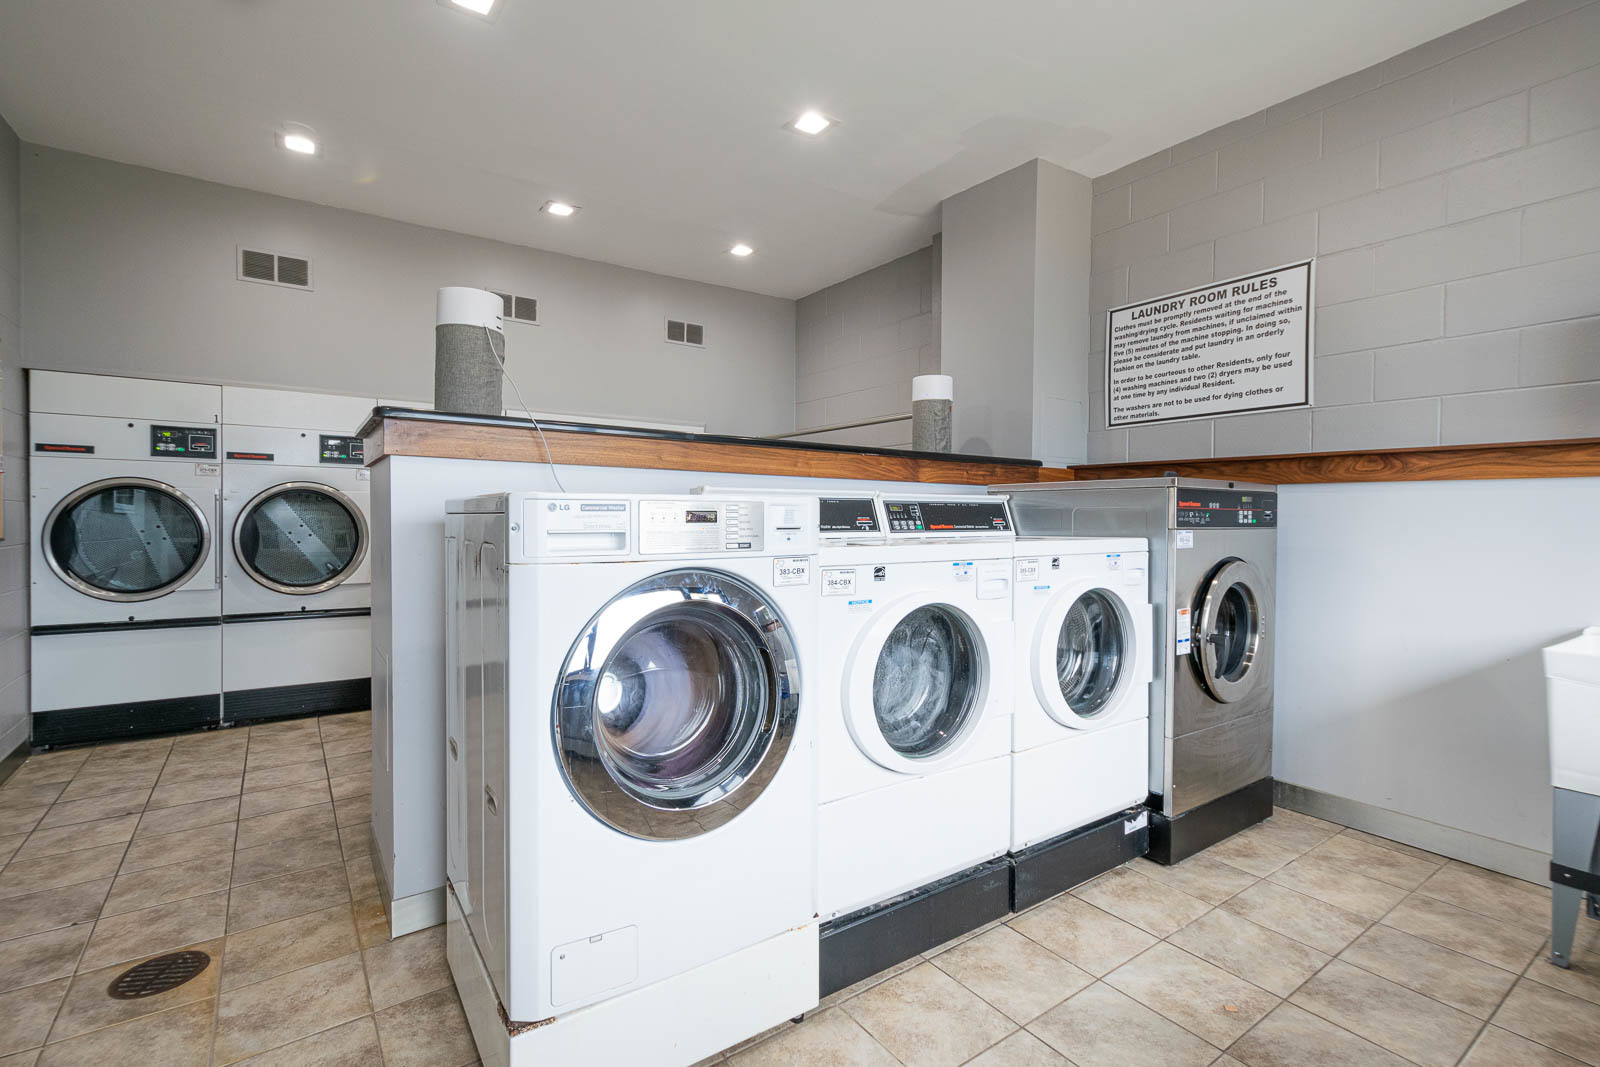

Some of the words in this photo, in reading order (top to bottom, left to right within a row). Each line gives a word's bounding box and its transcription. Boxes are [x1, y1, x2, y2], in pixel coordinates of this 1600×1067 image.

[1132, 299, 1186, 321] LAUNDRY
[1190, 289, 1228, 307] ROOM
[1232, 277, 1278, 297] RULES
[1180, 315, 1213, 327] Residents
[1215, 310, 1241, 319] waiting
[1243, 306, 1254, 314] for
[1256, 298, 1293, 310] machines
[1114, 324, 1136, 333] Clothes
[1138, 320, 1152, 328] must
[1163, 311, 1192, 323] promptly
[1194, 303, 1223, 315] removed
[1248, 294, 1262, 303] end
[1127, 338, 1149, 346] remove
[1150, 332, 1174, 341] laundry
[1236, 310, 1276, 324] unclaimed
[1277, 305, 1302, 315] within
[1113, 358, 1133, 366] please
[1143, 348, 1180, 360] considerate
[1195, 342, 1206, 351] put
[1208, 338, 1234, 347] laundry
[1256, 328, 1284, 338] orderly
[1135, 344, 1159, 353] minutes
[1181, 334, 1209, 344] machine
[1255, 321, 1276, 329] doing
[1114, 365, 1134, 373] fashion
[1156, 357, 1180, 366] laundry
[1148, 379, 1178, 388] machines
[1219, 369, 1242, 378] dryers
[1274, 360, 1292, 368] used
[1154, 369, 1186, 378] courteous
[1196, 364, 1215, 372] other
[1256, 354, 1273, 362] only
[1169, 383, 1201, 393] individual
[1194, 395, 1210, 403] used
[1224, 392, 1243, 400] dying
[1245, 388, 1273, 396] clothes
[214, 414, 218, 423] 1
